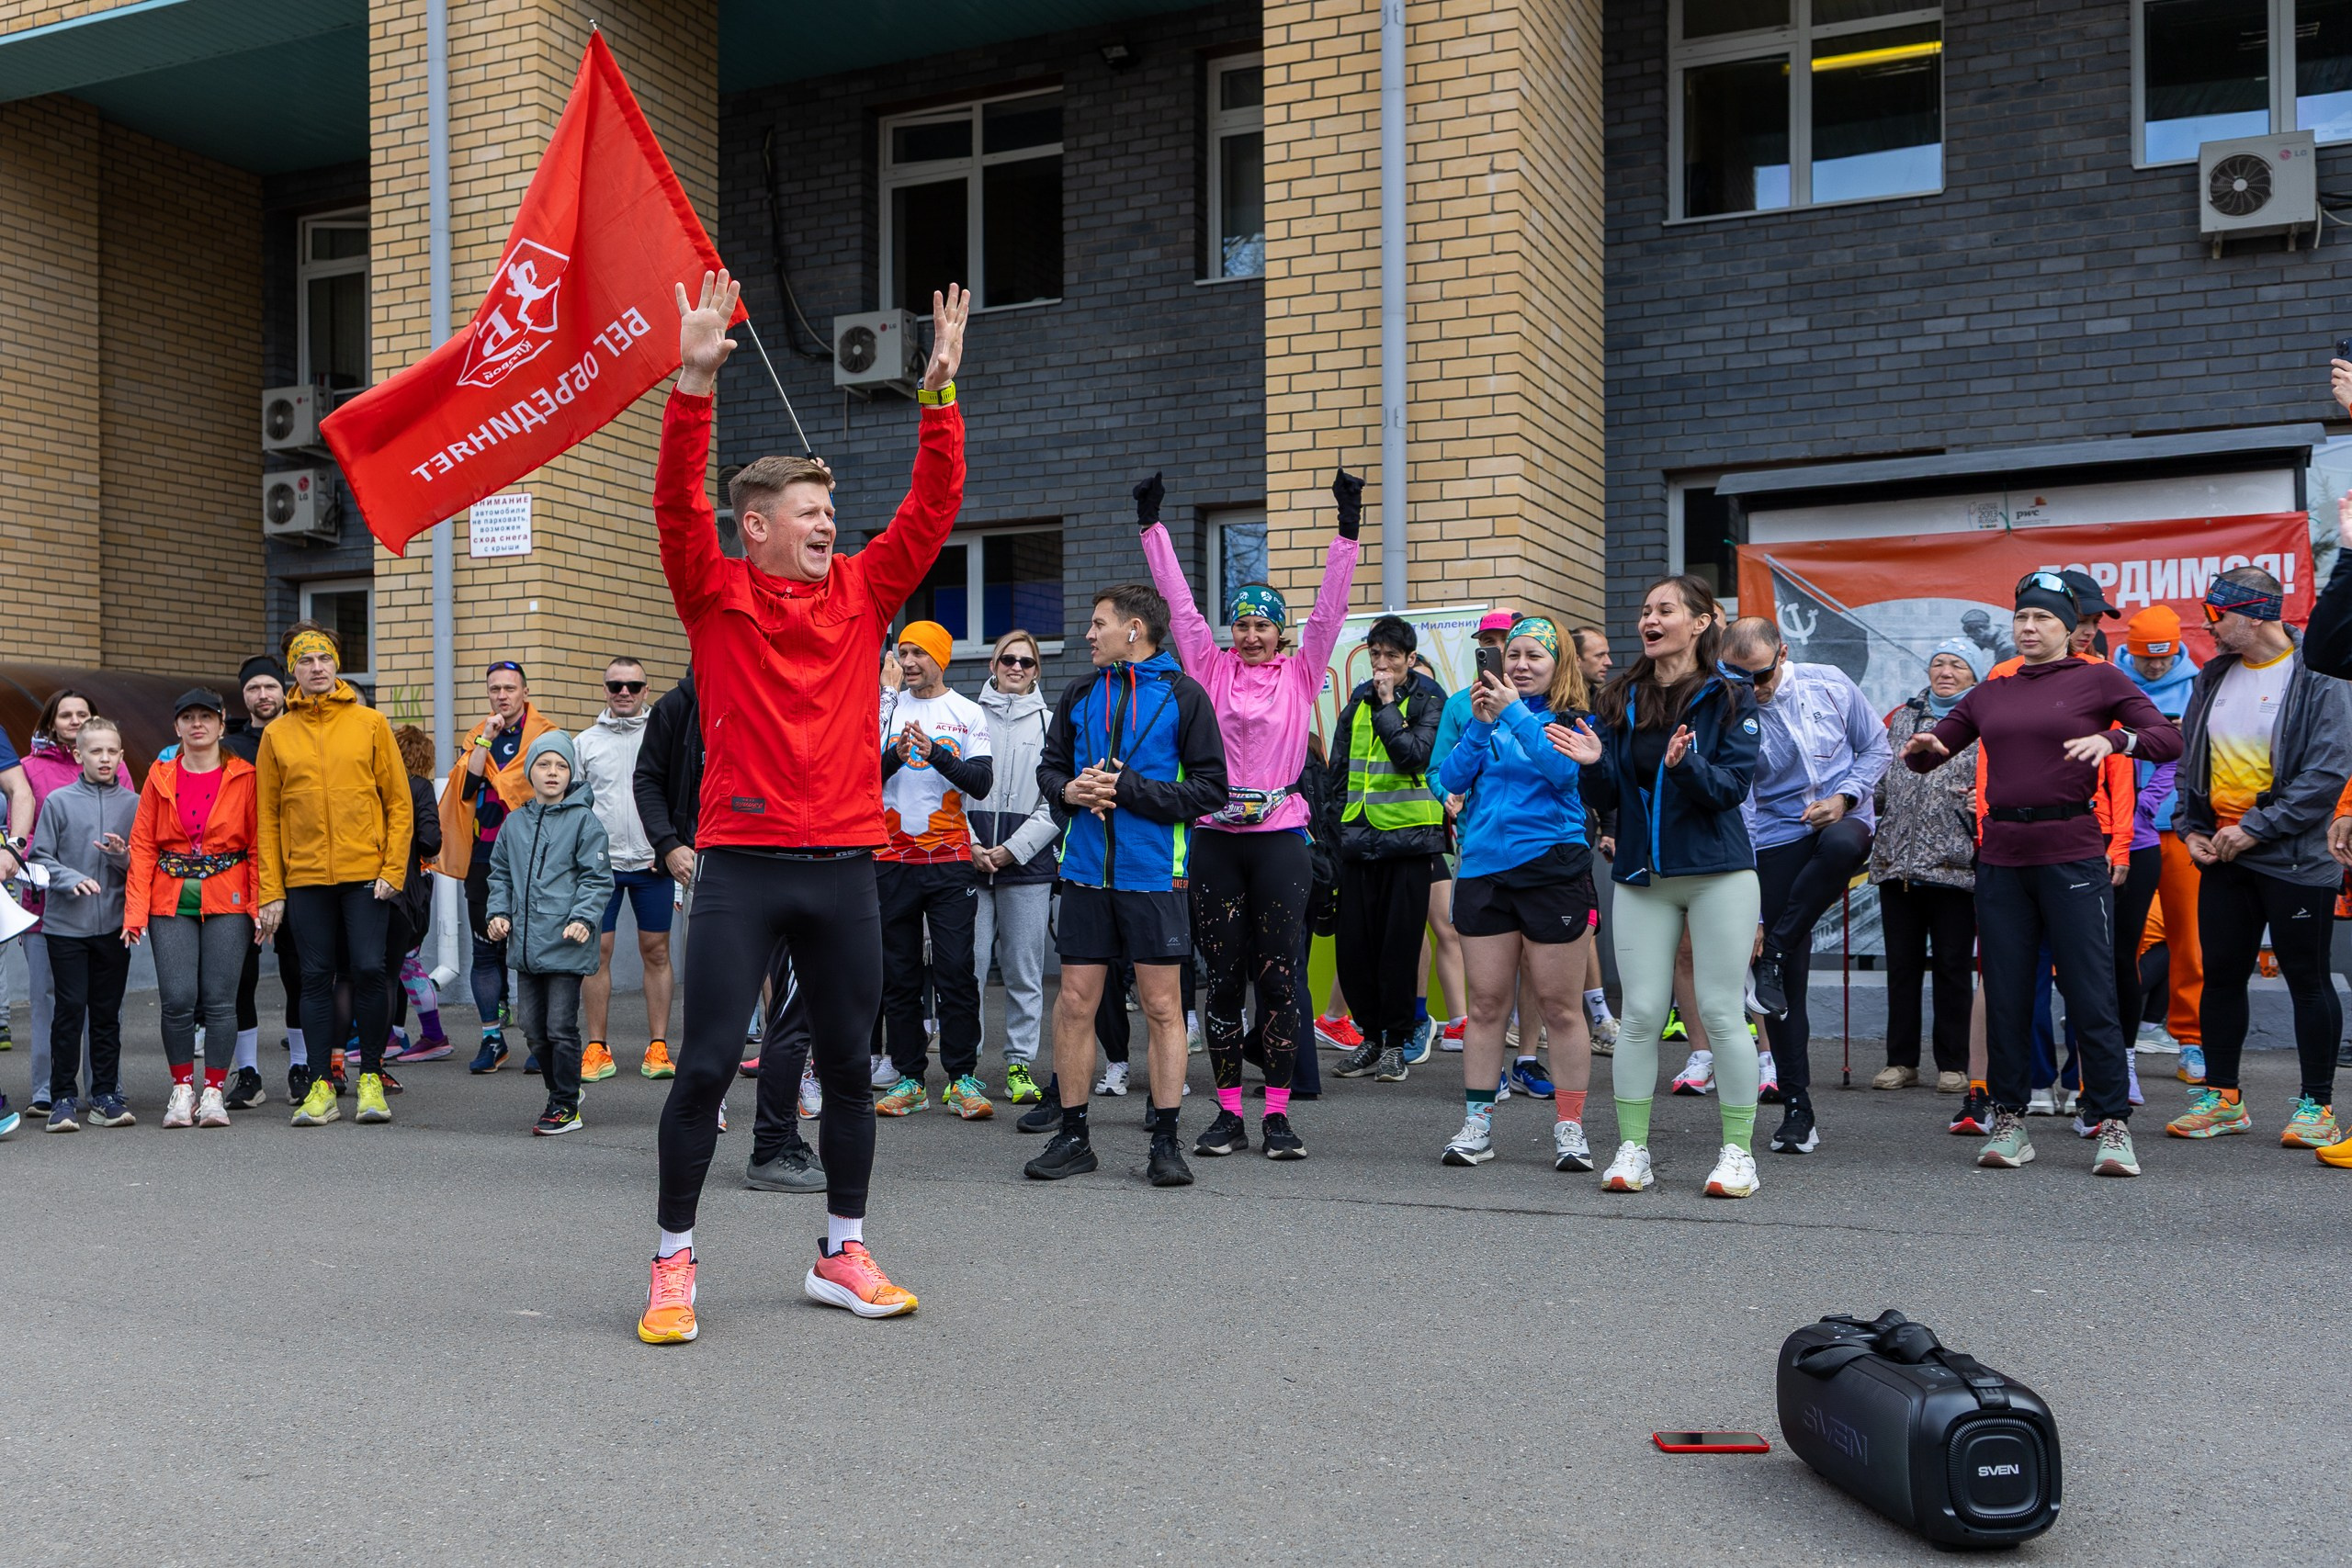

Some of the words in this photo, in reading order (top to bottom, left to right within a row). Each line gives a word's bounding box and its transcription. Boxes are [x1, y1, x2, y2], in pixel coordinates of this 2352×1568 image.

[299, 493, 309, 502] LG
[475, 507, 526, 516] автомобили
[2016, 509, 2041, 520] pwc
[484, 516, 528, 525] парковать,
[1420, 619, 1481, 630] Миллениу
[935, 724, 968, 735] АСТРУМ
[1803, 1403, 1868, 1466] SVEN
[1978, 1463, 2019, 1477] SVEN
